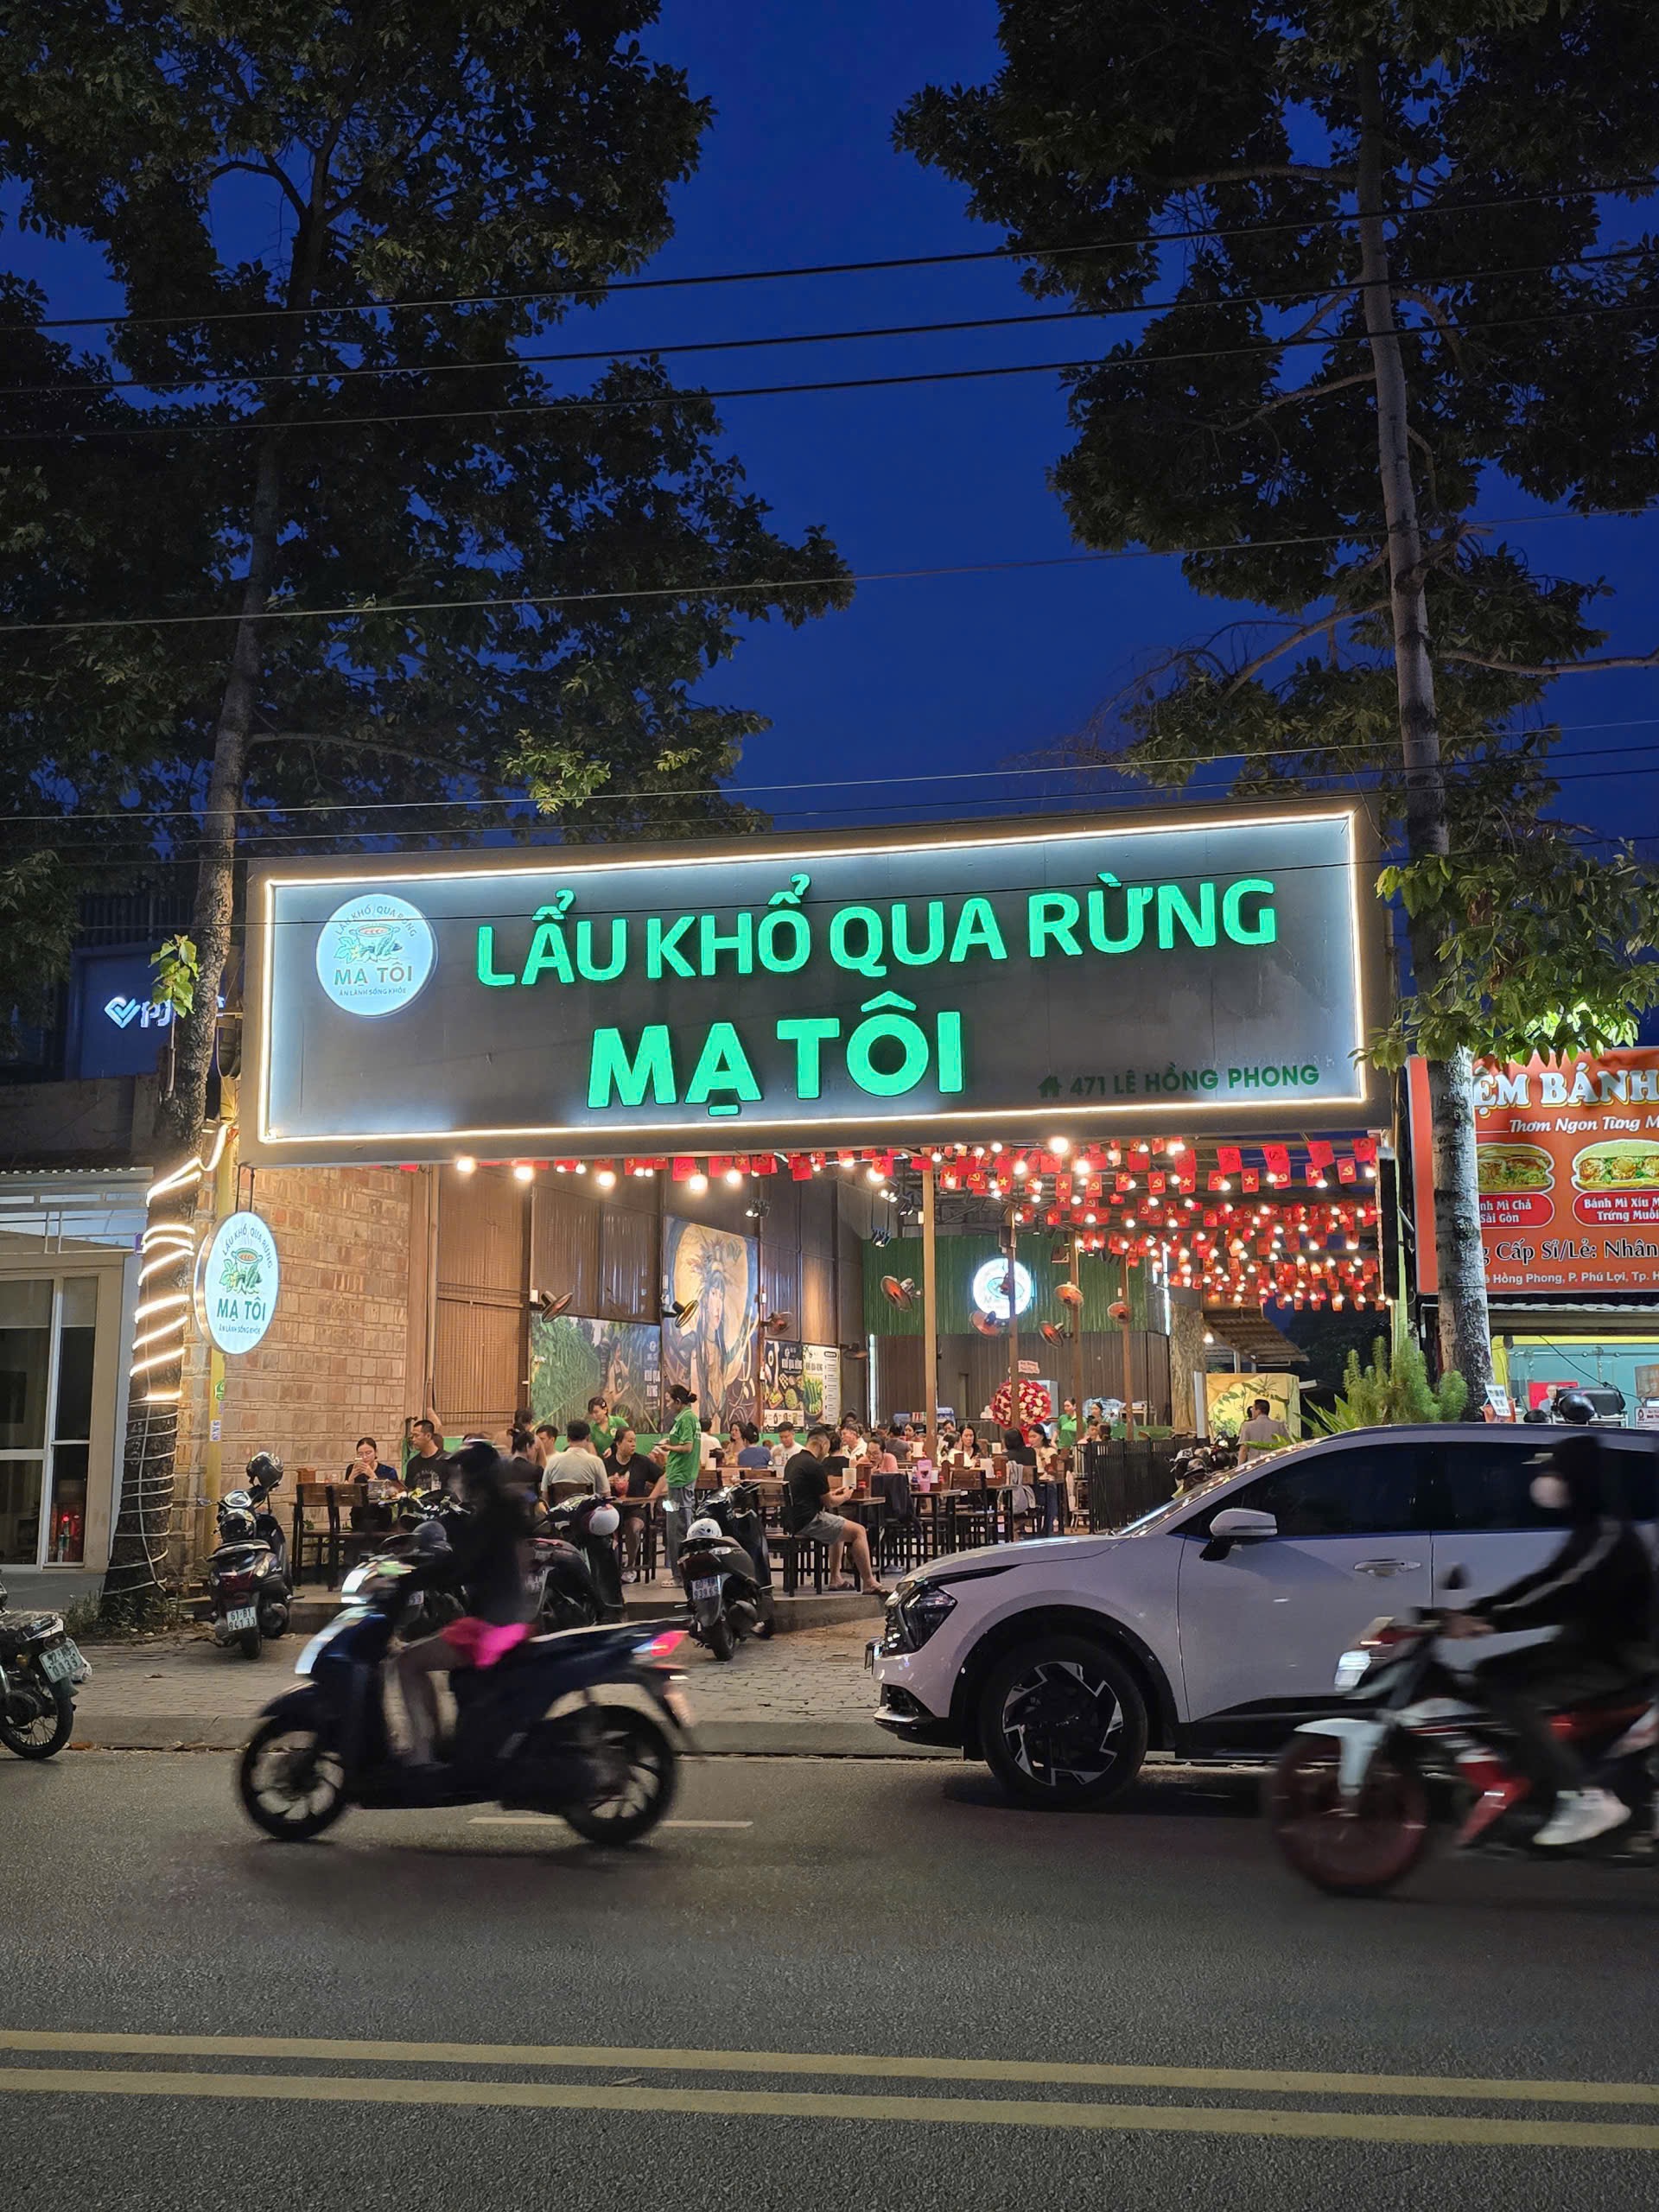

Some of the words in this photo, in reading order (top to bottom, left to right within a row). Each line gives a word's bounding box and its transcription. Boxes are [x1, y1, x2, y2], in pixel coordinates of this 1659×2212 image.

[377, 906, 396, 918] QUA
[476, 887, 627, 987] LẨU
[646, 874, 811, 979] KHỔ
[830, 897, 1008, 977] QUA
[1028, 872, 1276, 958] RỪNG
[334, 968, 369, 987] MẠ
[377, 962, 412, 983] TÔI
[588, 1022, 761, 1116] MẠ
[776, 990, 963, 1099] TÔI
[1070, 1076, 1105, 1096] 471
[1114, 1070, 1136, 1095] LÊ
[1145, 1062, 1219, 1093] HỒNG
[1228, 1064, 1319, 1089] PHONG
[1539, 1062, 1659, 1108] BÁNH
[1510, 1119, 1552, 1133] Thơm
[1555, 1117, 1599, 1134] Ngon
[1497, 1199, 1510, 1211] Mì
[1584, 1197, 1611, 1209] Bánh
[1615, 1197, 1628, 1208] Mì
[1480, 1212, 1496, 1224] Sài
[1499, 1211, 1520, 1224] Gòn
[1496, 1237, 1535, 1266] Cấp
[1603, 1237, 1658, 1258] Nhân
[1581, 1271, 1604, 1282] Phú
[1631, 1271, 1649, 1283] Tp.
[217, 1298, 238, 1322] MẠ
[245, 1296, 266, 1321] TÔI
